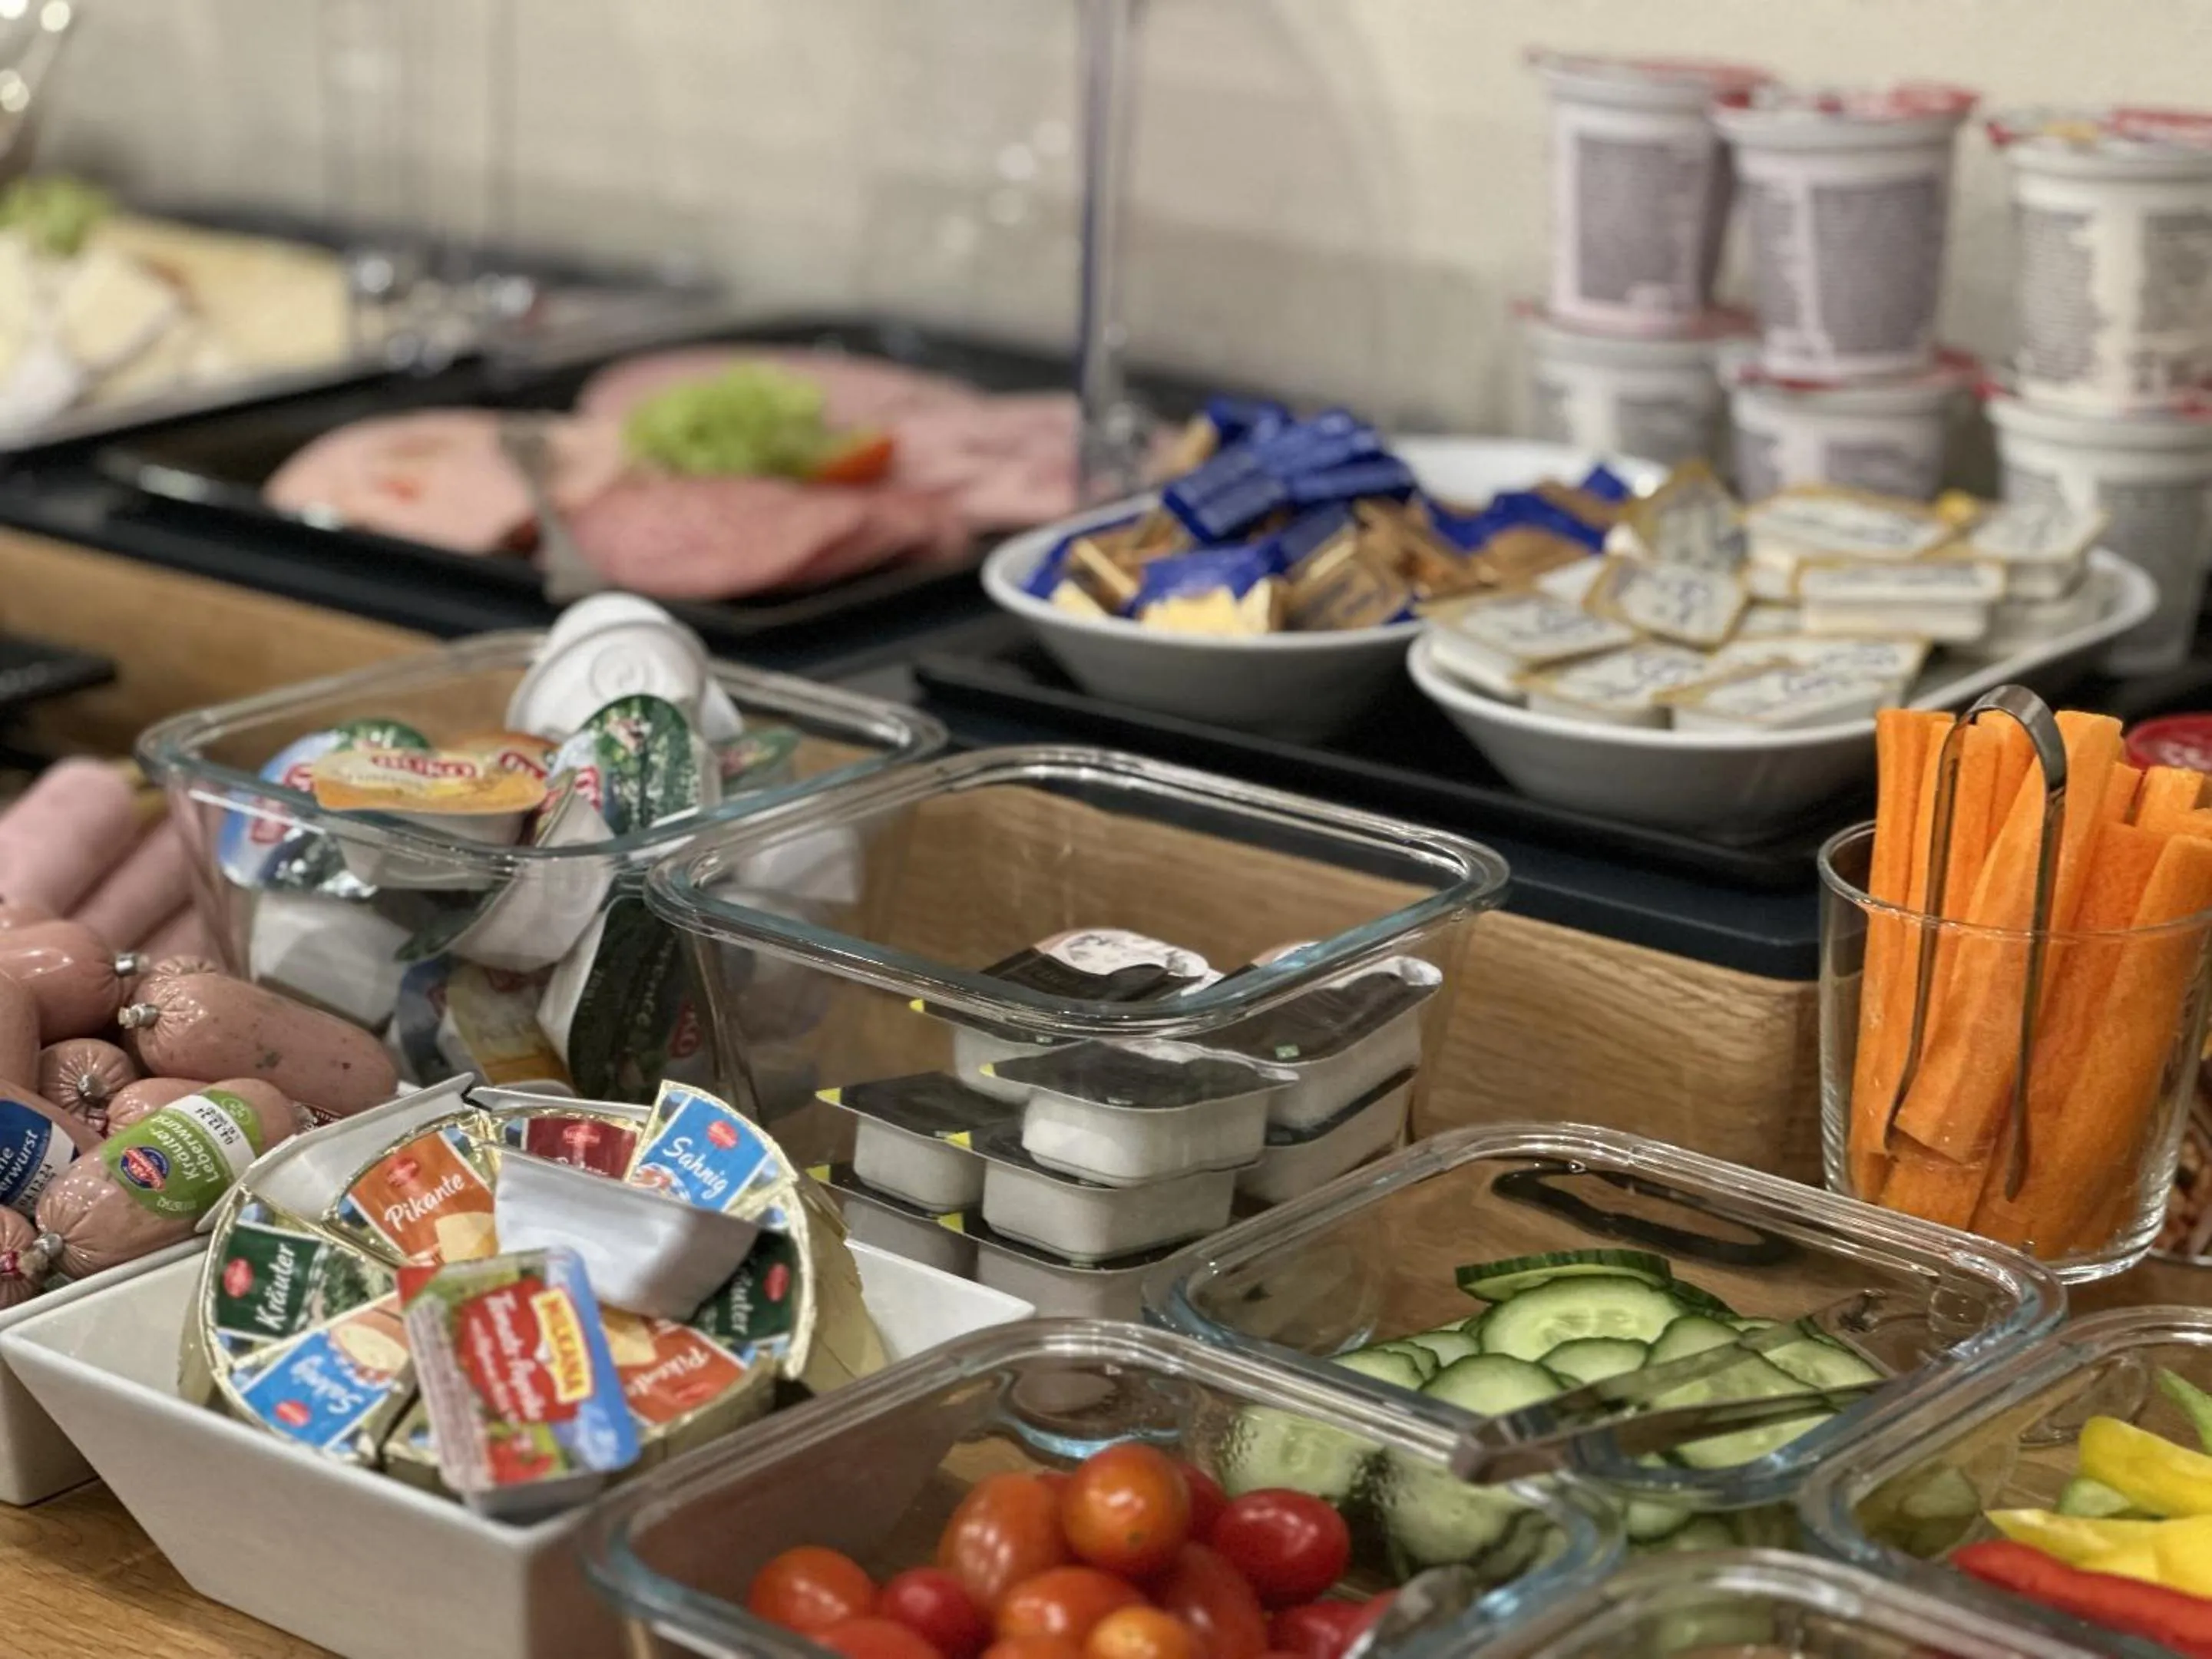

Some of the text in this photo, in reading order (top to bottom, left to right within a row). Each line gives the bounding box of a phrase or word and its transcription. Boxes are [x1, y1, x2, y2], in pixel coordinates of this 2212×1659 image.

[662, 1136, 729, 1200] Sahnig
[384, 1173, 465, 1232] Pikante
[254, 1242, 296, 1331] Kräuter
